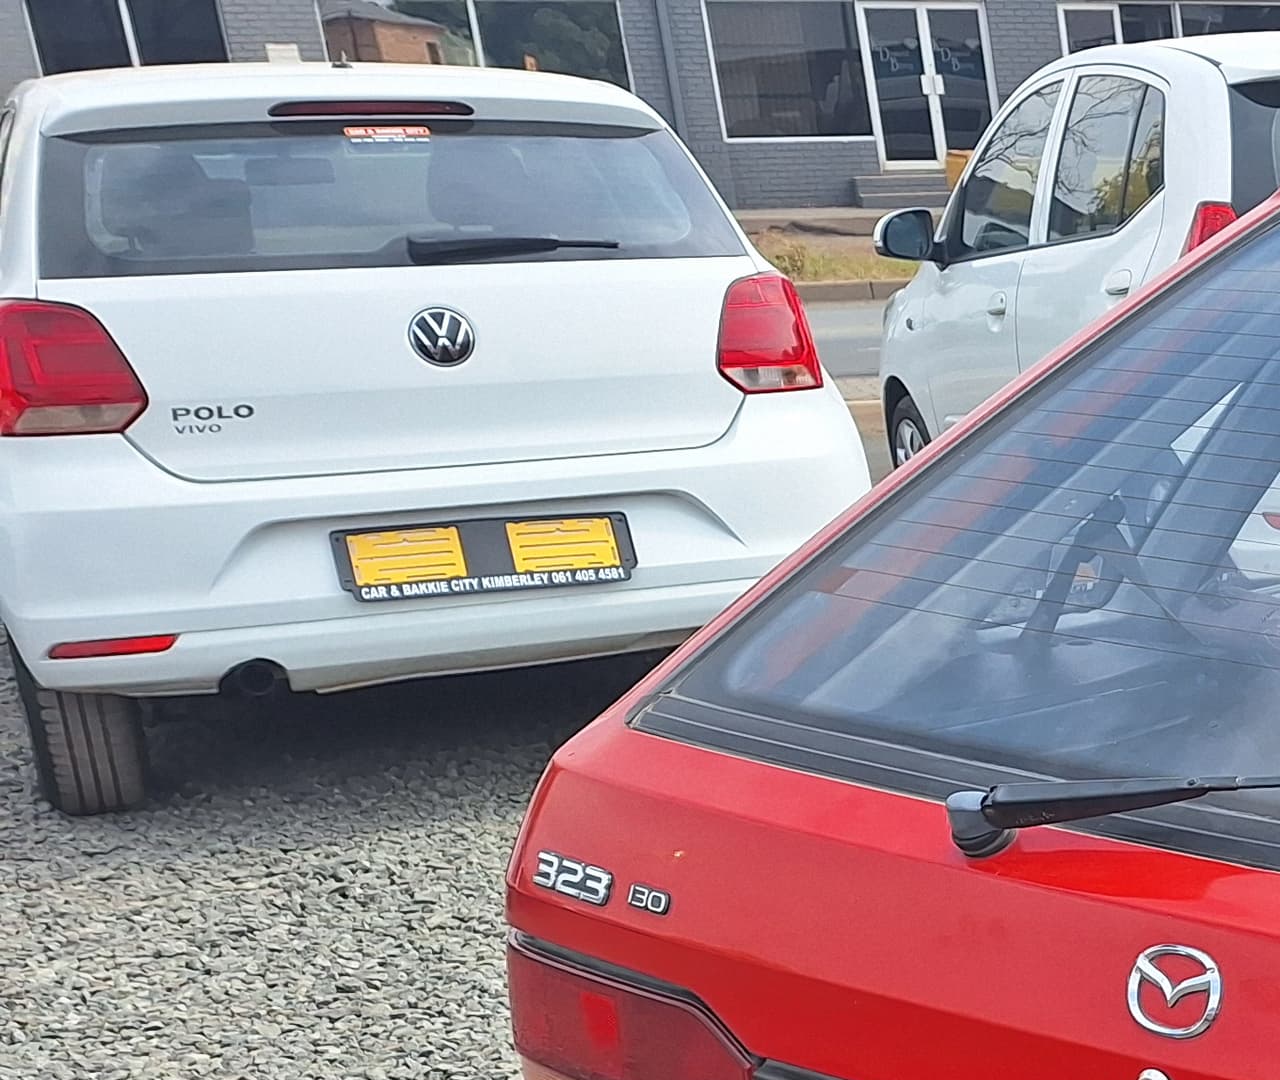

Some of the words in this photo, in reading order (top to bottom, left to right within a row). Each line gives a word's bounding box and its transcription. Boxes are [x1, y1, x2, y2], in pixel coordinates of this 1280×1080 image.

[171, 404, 254, 421] POLO
[174, 423, 222, 434] VIVO
[361, 585, 389, 599] CAR
[390, 584, 401, 597] &
[401, 579, 449, 596] BAKKIE
[450, 577, 480, 592] CITY
[481, 571, 549, 589] KIMBERLEY
[551, 569, 573, 584] 061
[575, 567, 596, 581] 405
[598, 565, 626, 579] 4581
[532, 851, 612, 905] 323
[627, 884, 669, 914] 130
